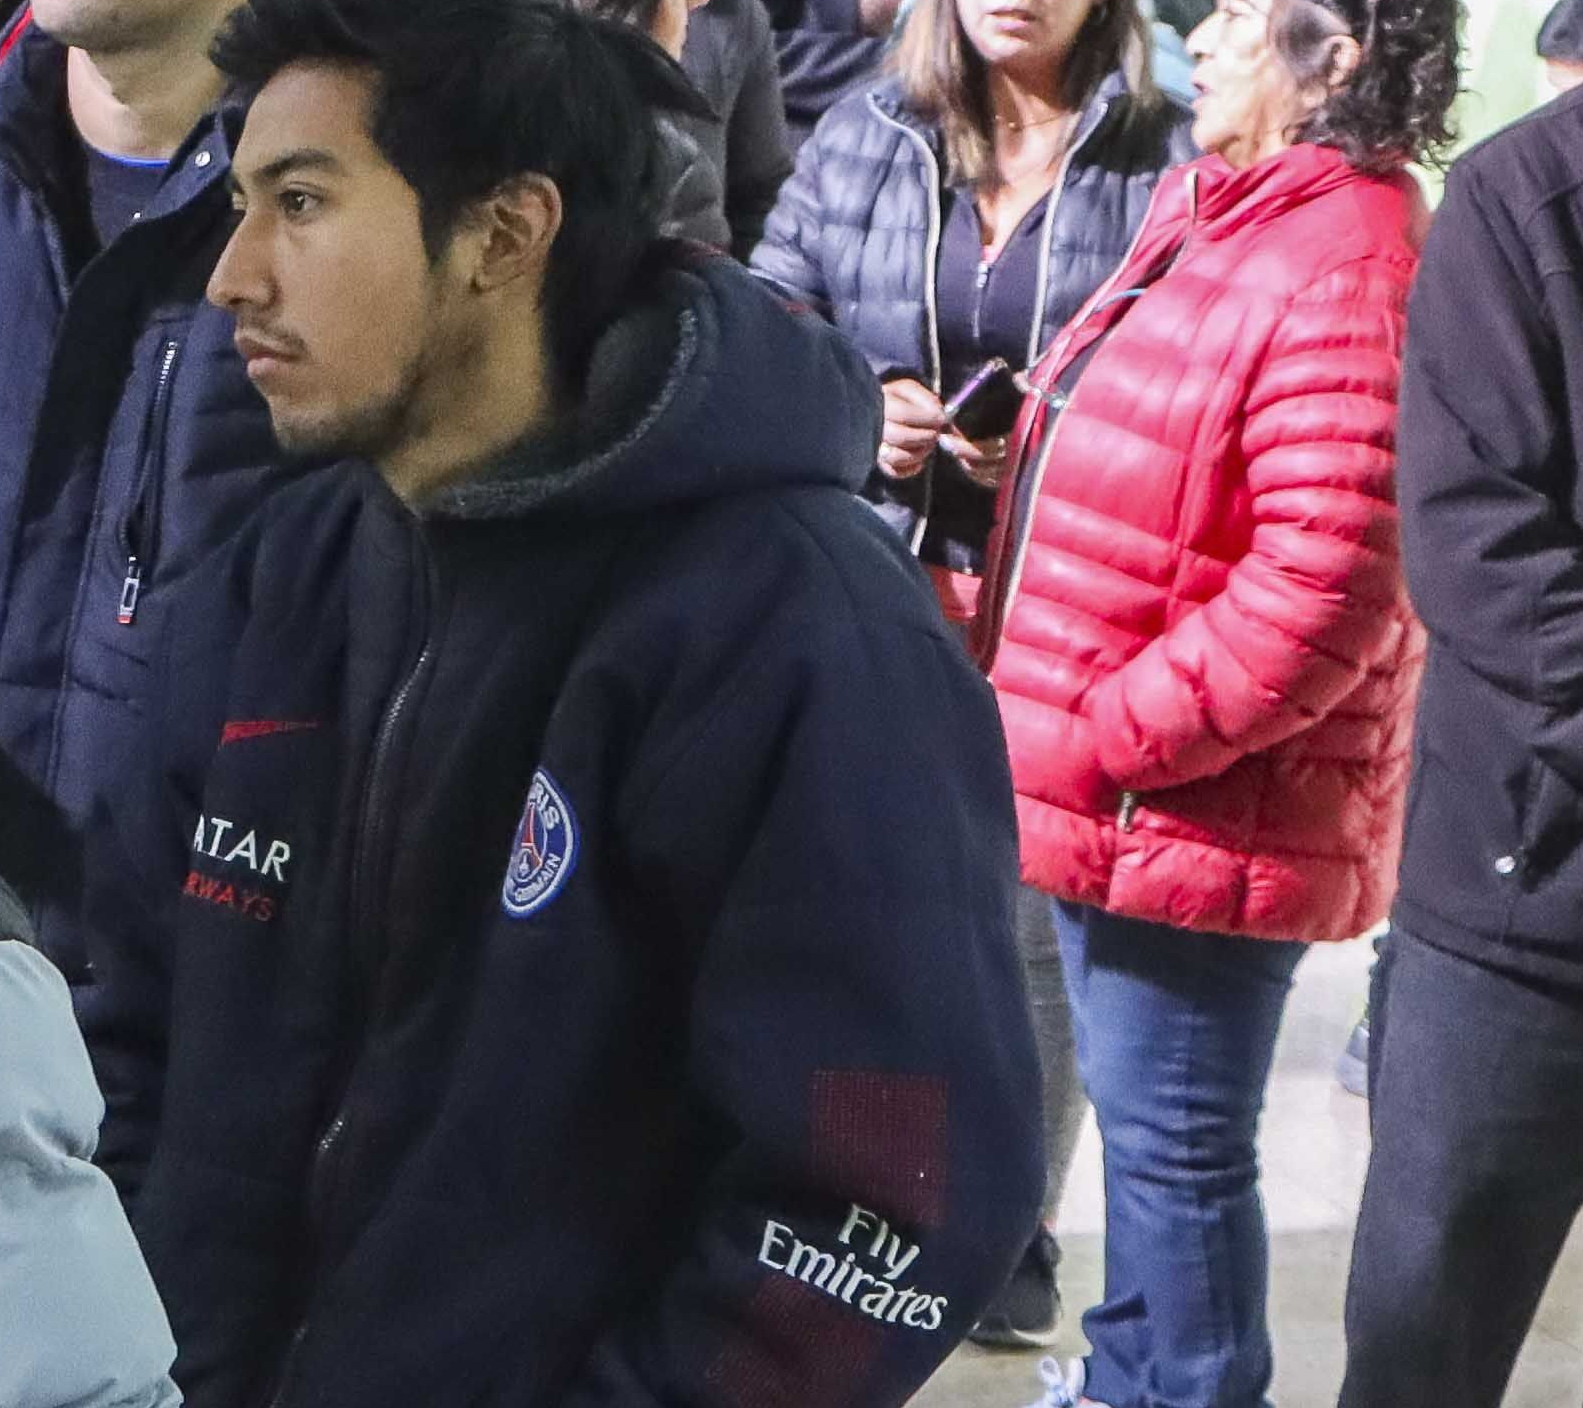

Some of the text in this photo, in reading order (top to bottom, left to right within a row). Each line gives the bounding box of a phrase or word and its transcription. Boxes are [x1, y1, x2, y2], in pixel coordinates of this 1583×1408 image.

[193, 813, 291, 882] ATAR
[758, 1219, 948, 1331] Emirates
[838, 1202, 921, 1281] Fly
